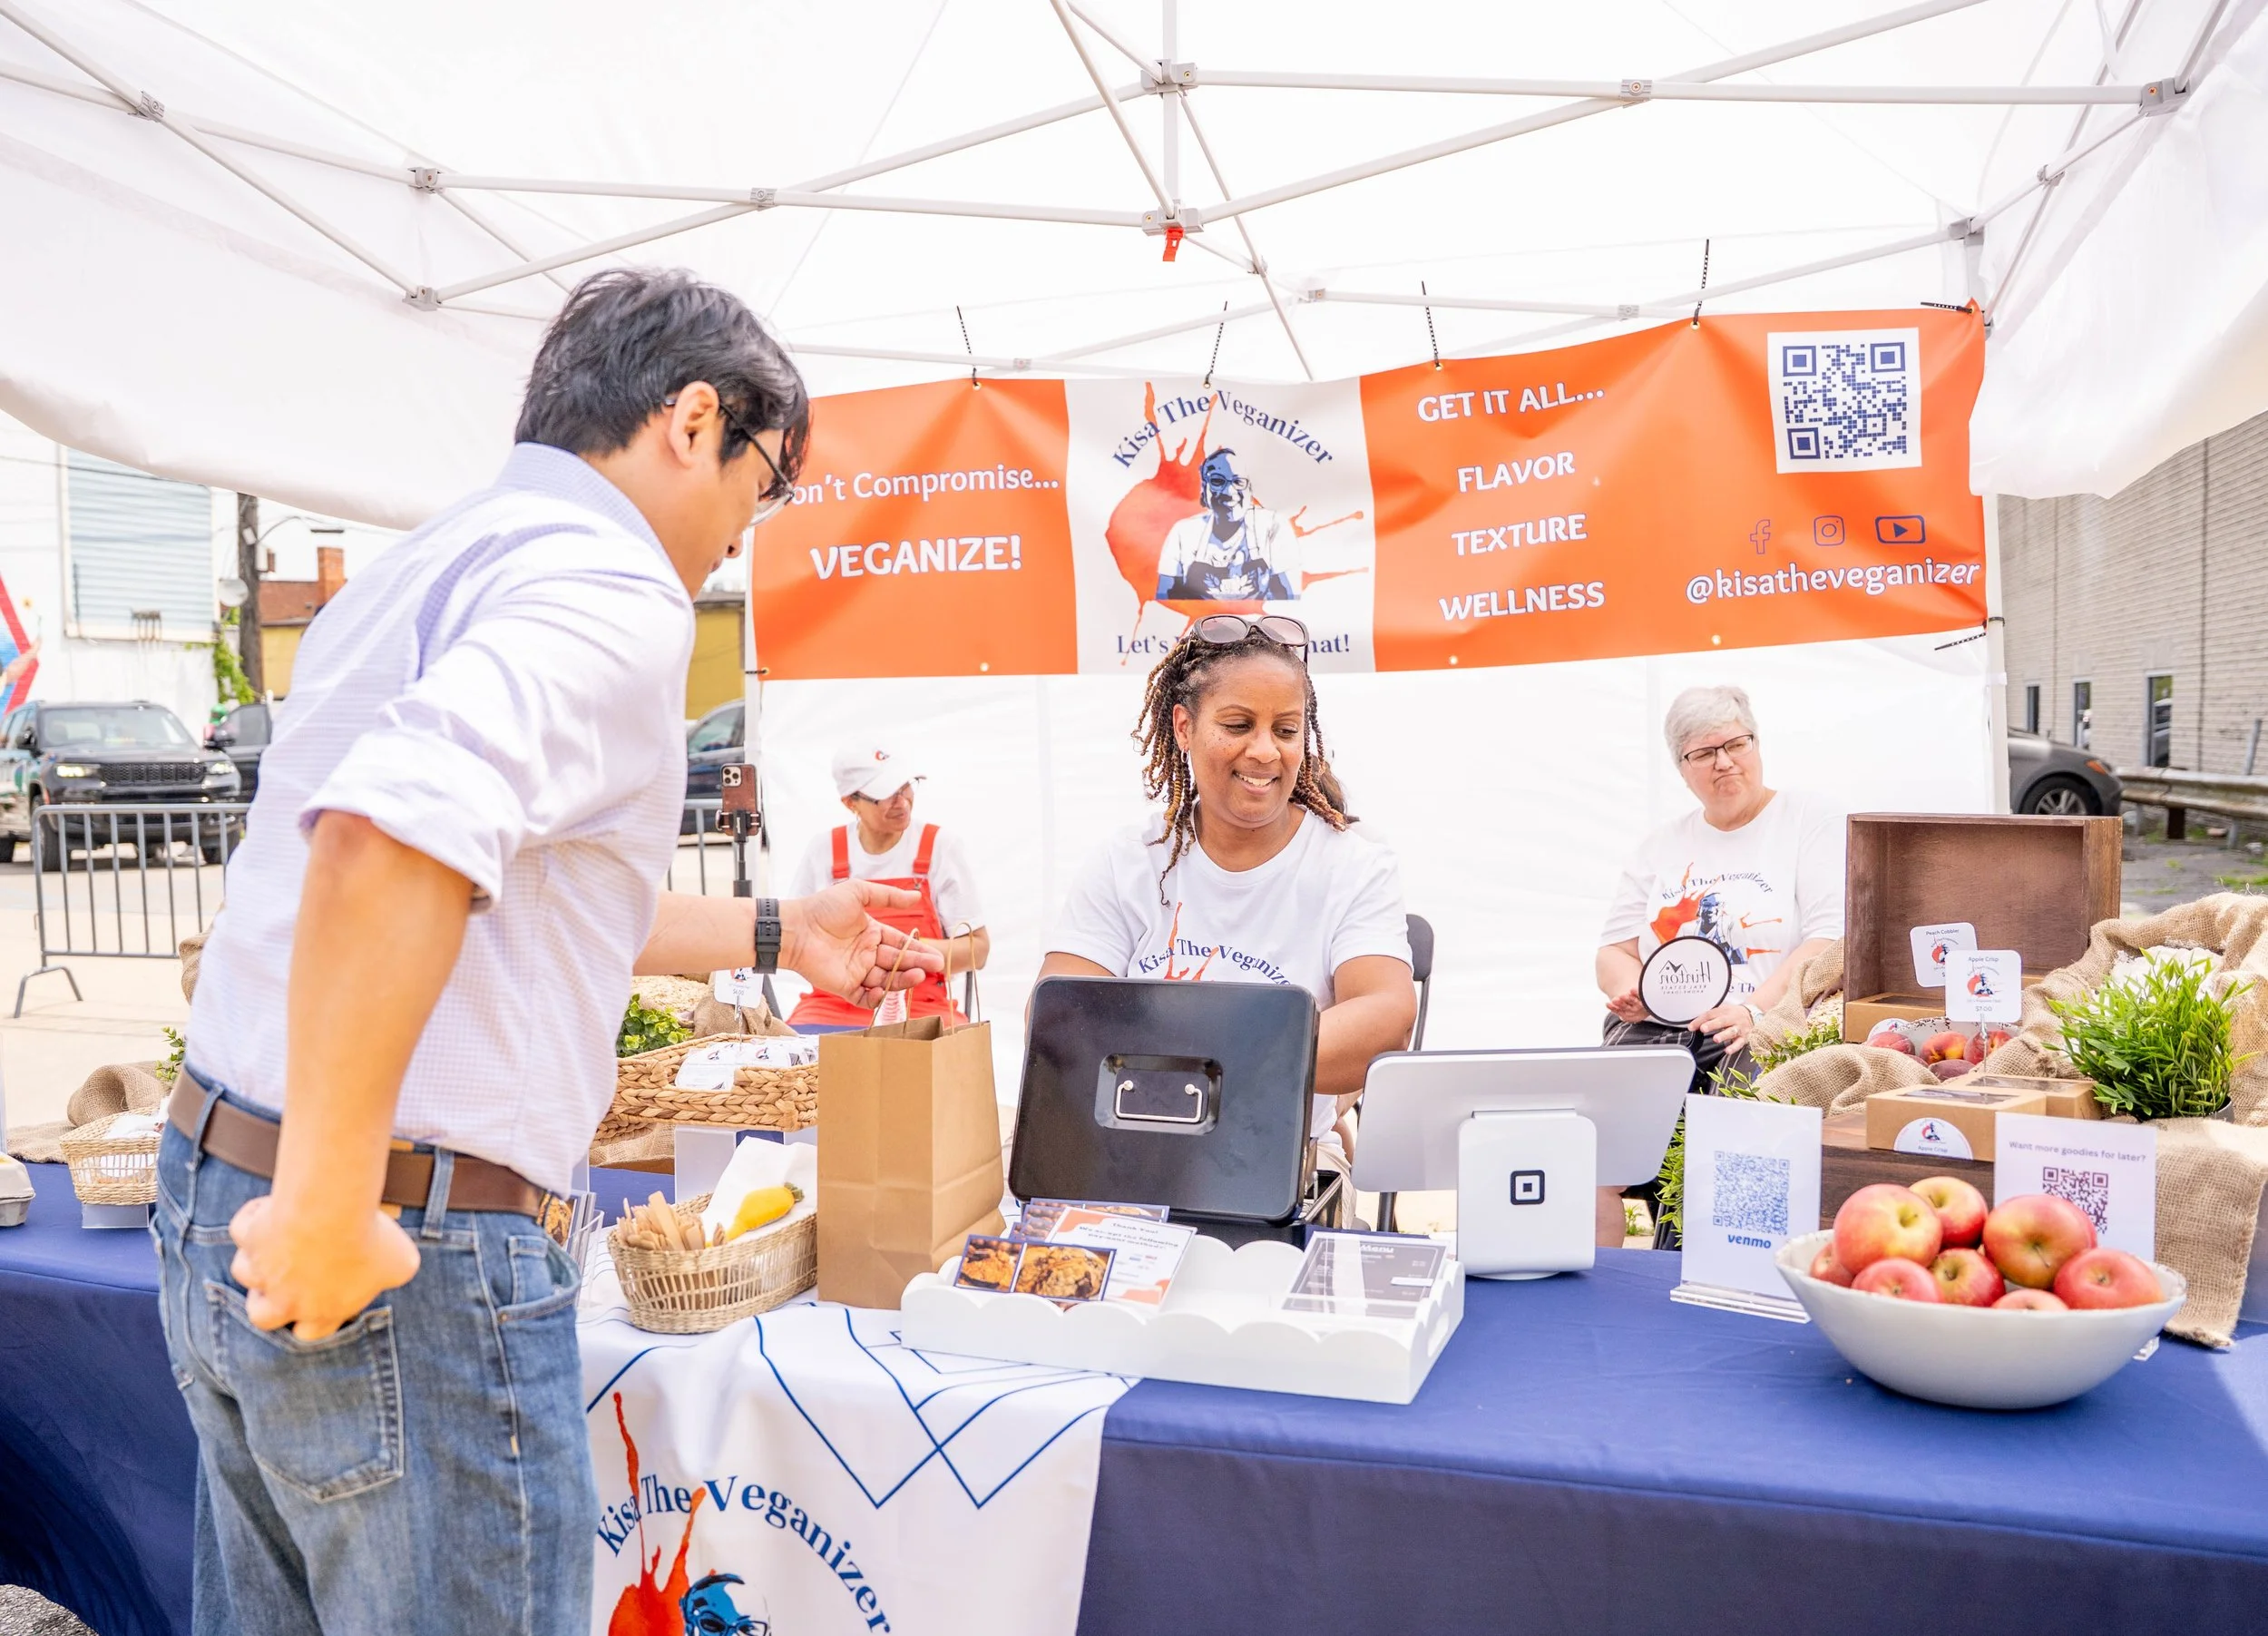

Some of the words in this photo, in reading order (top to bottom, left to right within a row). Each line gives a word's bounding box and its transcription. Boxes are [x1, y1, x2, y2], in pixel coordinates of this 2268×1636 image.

[1417, 391, 1475, 422] GET
[1482, 389, 1510, 415] IT
[1519, 382, 1605, 413] ALL...
[1111, 419, 1161, 469] Kisa
[1157, 395, 1212, 425] The
[1217, 389, 1334, 466] Veganizer
[792, 473, 846, 505] on't
[853, 464, 1060, 502] Compromise...
[1457, 451, 1576, 494] FLAVOR
[1452, 514, 1588, 556] TEXTURE
[809, 534, 1022, 580] VEGANIZE!
[1438, 581, 1606, 622] WELLNESS
[1686, 557, 1981, 605] @kisatheveganizer
[1117, 634, 1169, 654] Let's
[1721, 871, 1774, 895] Veganizer
[1138, 946, 1176, 974] Kisa
[1177, 938, 1212, 957] The
[2009, 1141, 2033, 1151] Want
[2035, 1145, 2058, 1153] more
[2061, 1147, 2098, 1158] goodies
[2101, 1150, 2116, 1159] for
[2117, 1152, 2146, 1162] later?
[1360, 1244, 1394, 1254] Menu
[1727, 1234, 1772, 1249] venmo
[595, 1494, 642, 1558] Kisa
[640, 1474, 693, 1514] The
[703, 1475, 891, 1634] Veganizer
